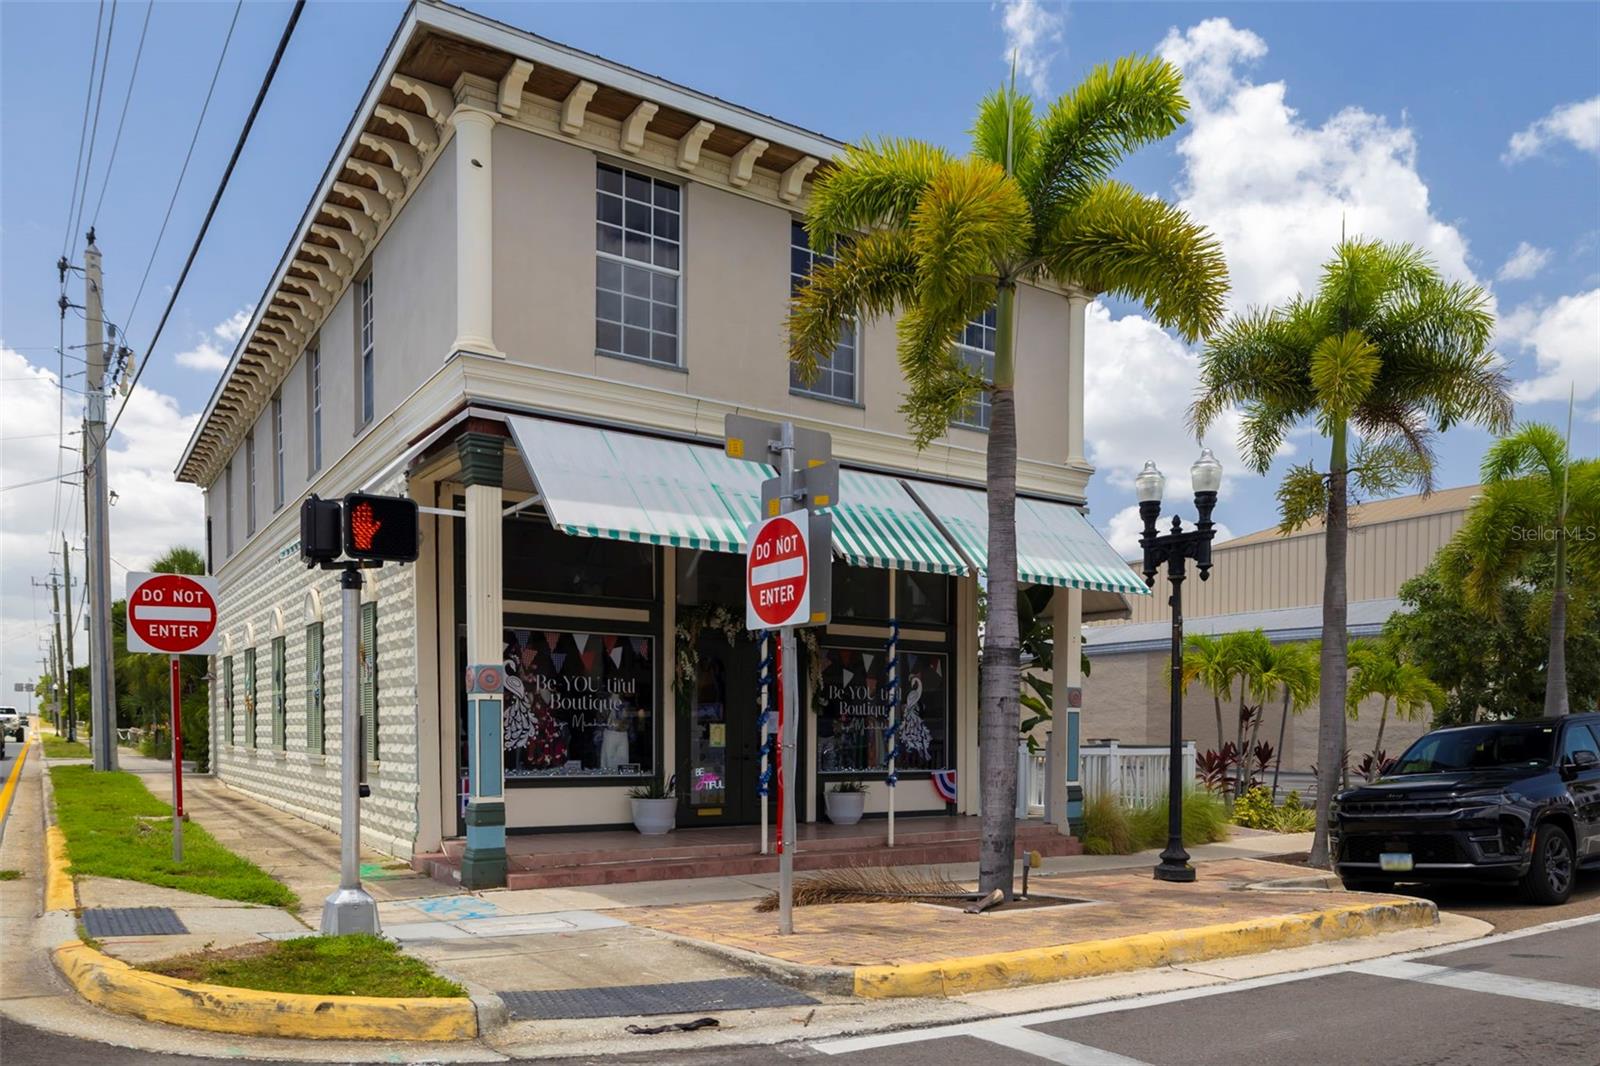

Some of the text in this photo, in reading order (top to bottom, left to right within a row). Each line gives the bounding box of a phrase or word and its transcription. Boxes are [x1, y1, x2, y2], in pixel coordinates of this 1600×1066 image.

[756, 535, 798, 560] DO NOT
[142, 589, 203, 603] DO NOT
[760, 585, 794, 606] ENTER
[149, 624, 198, 638] ENTER
[550, 694, 623, 713] Boutique
[840, 701, 890, 718] Boutiqu
